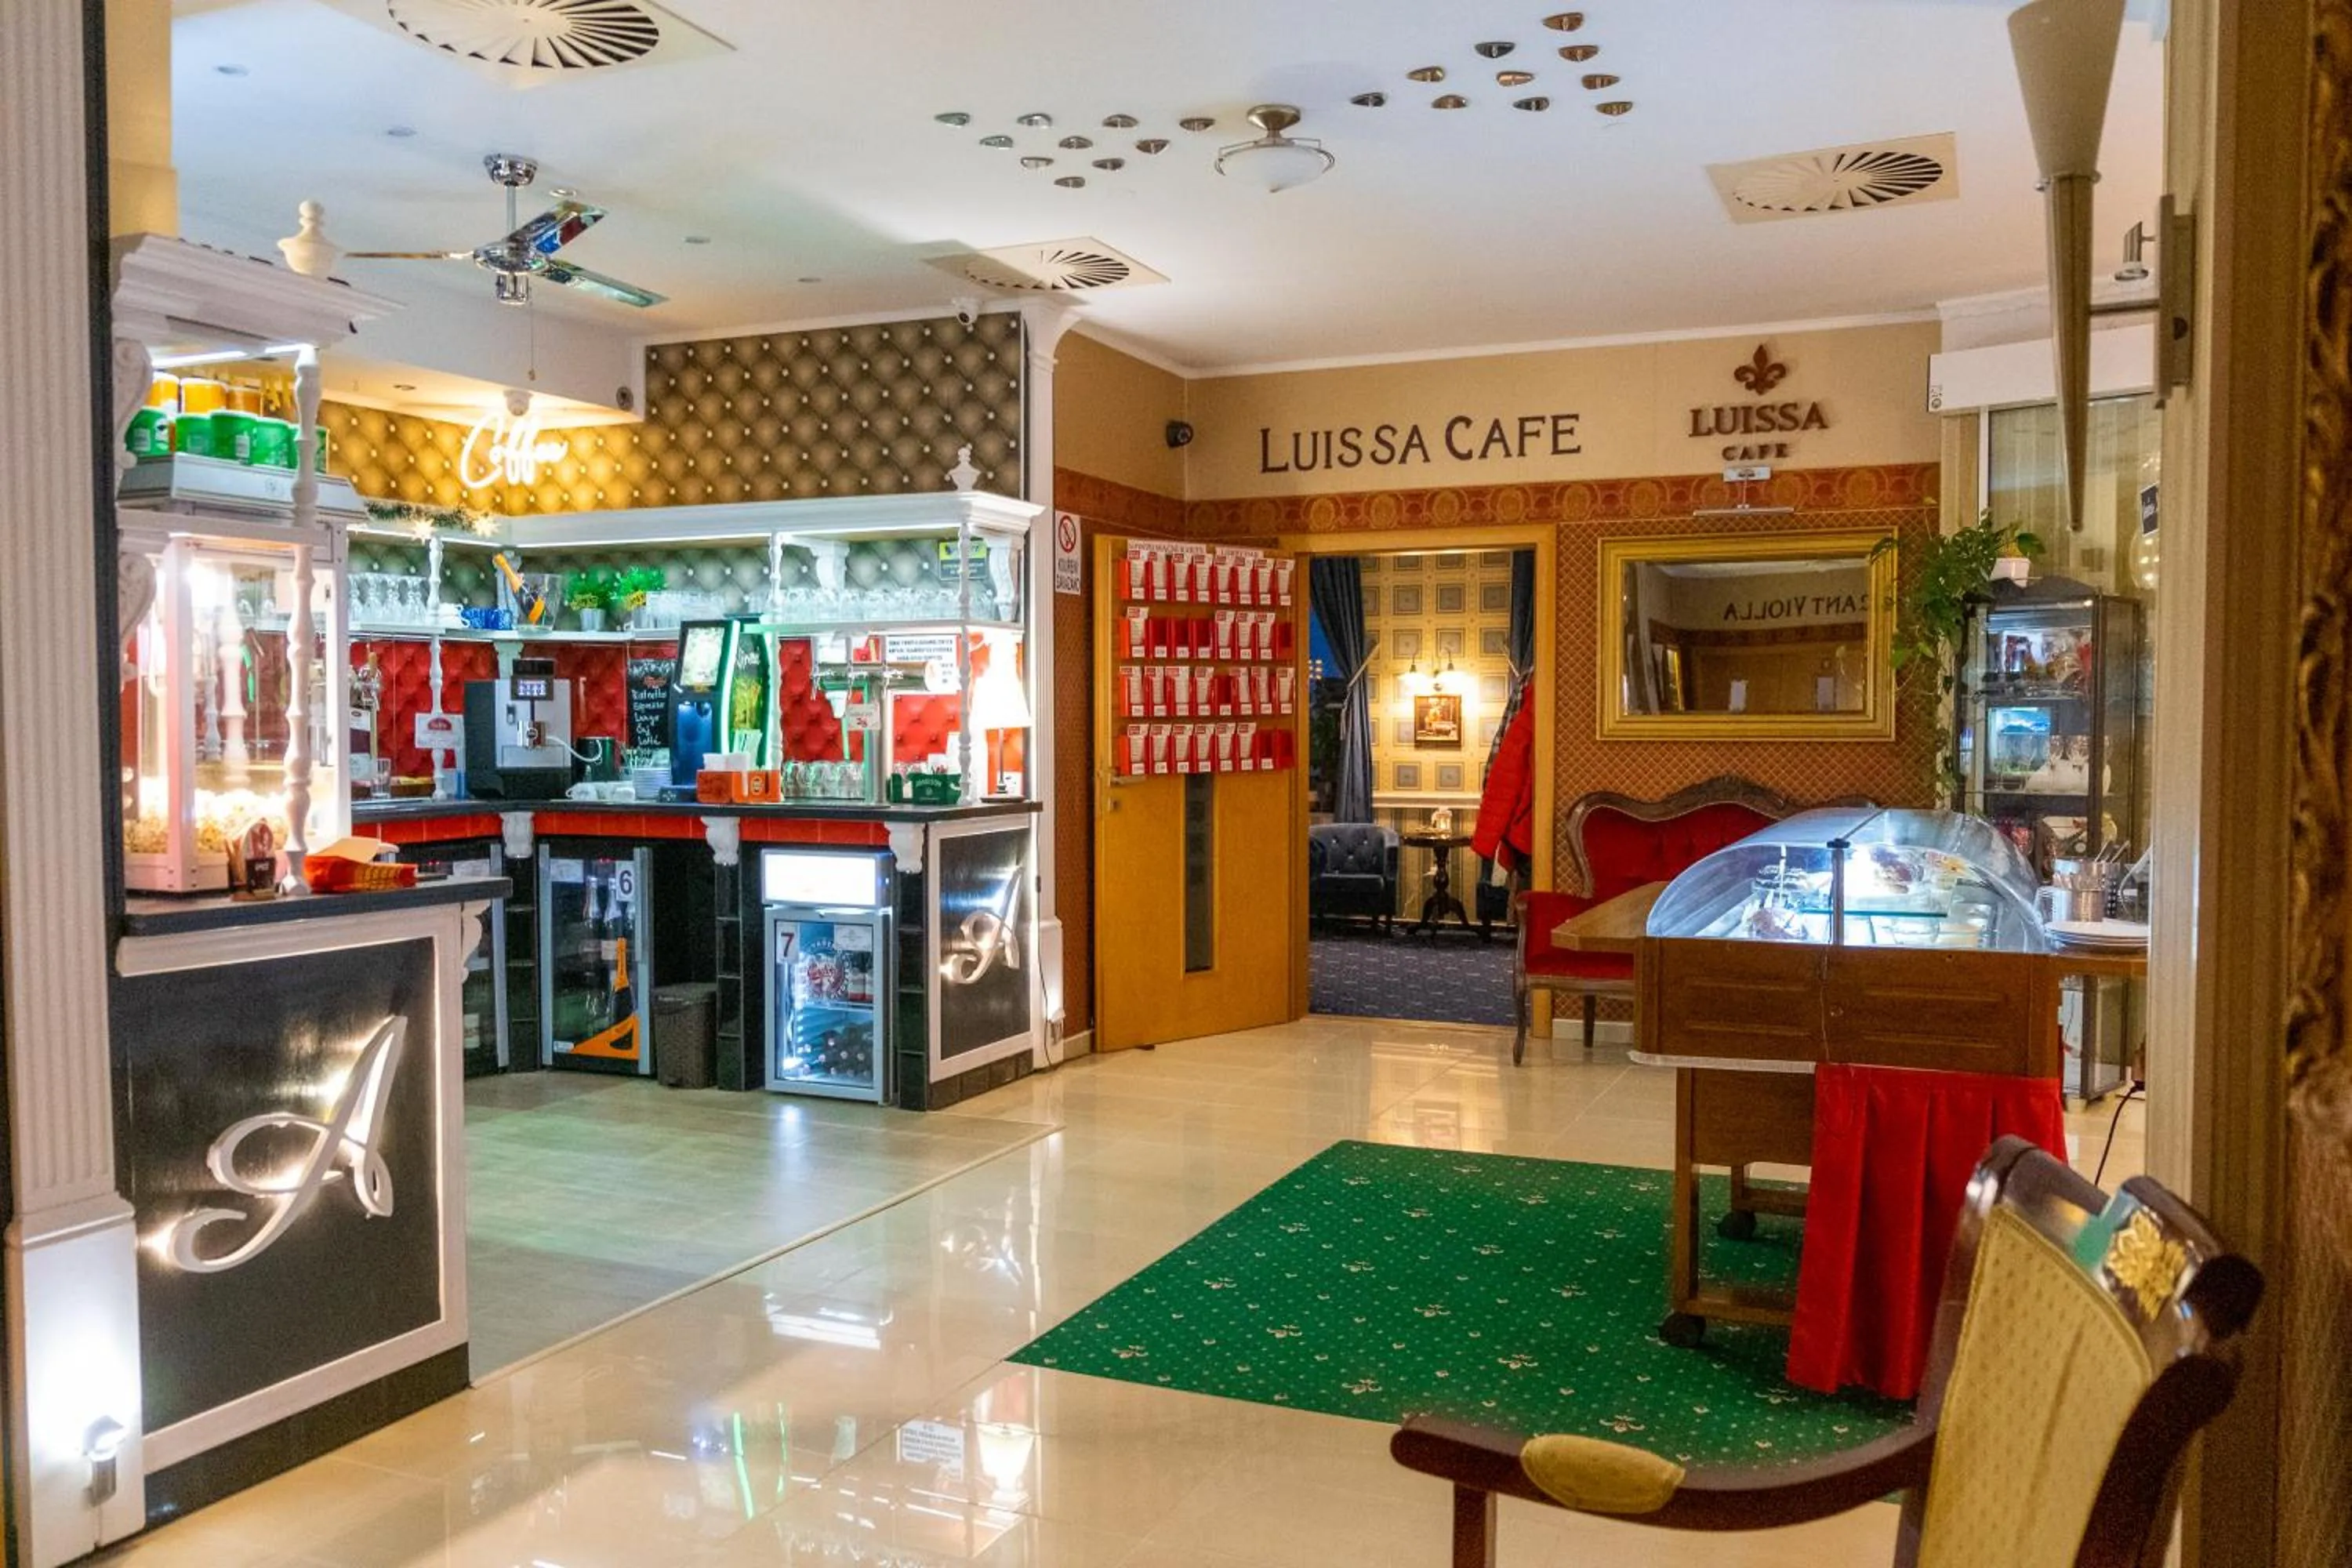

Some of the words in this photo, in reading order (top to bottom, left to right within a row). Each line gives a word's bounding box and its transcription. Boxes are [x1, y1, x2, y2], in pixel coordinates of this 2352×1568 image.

[1688, 401, 1829, 437] LUISSA
[460, 412, 568, 488] Coffee
[1260, 424, 1431, 474] LUISSA
[1445, 414, 1582, 460] CAFE
[1722, 442, 1789, 461] CAFE
[619, 870, 633, 895] 6
[780, 932, 795, 957] 7
